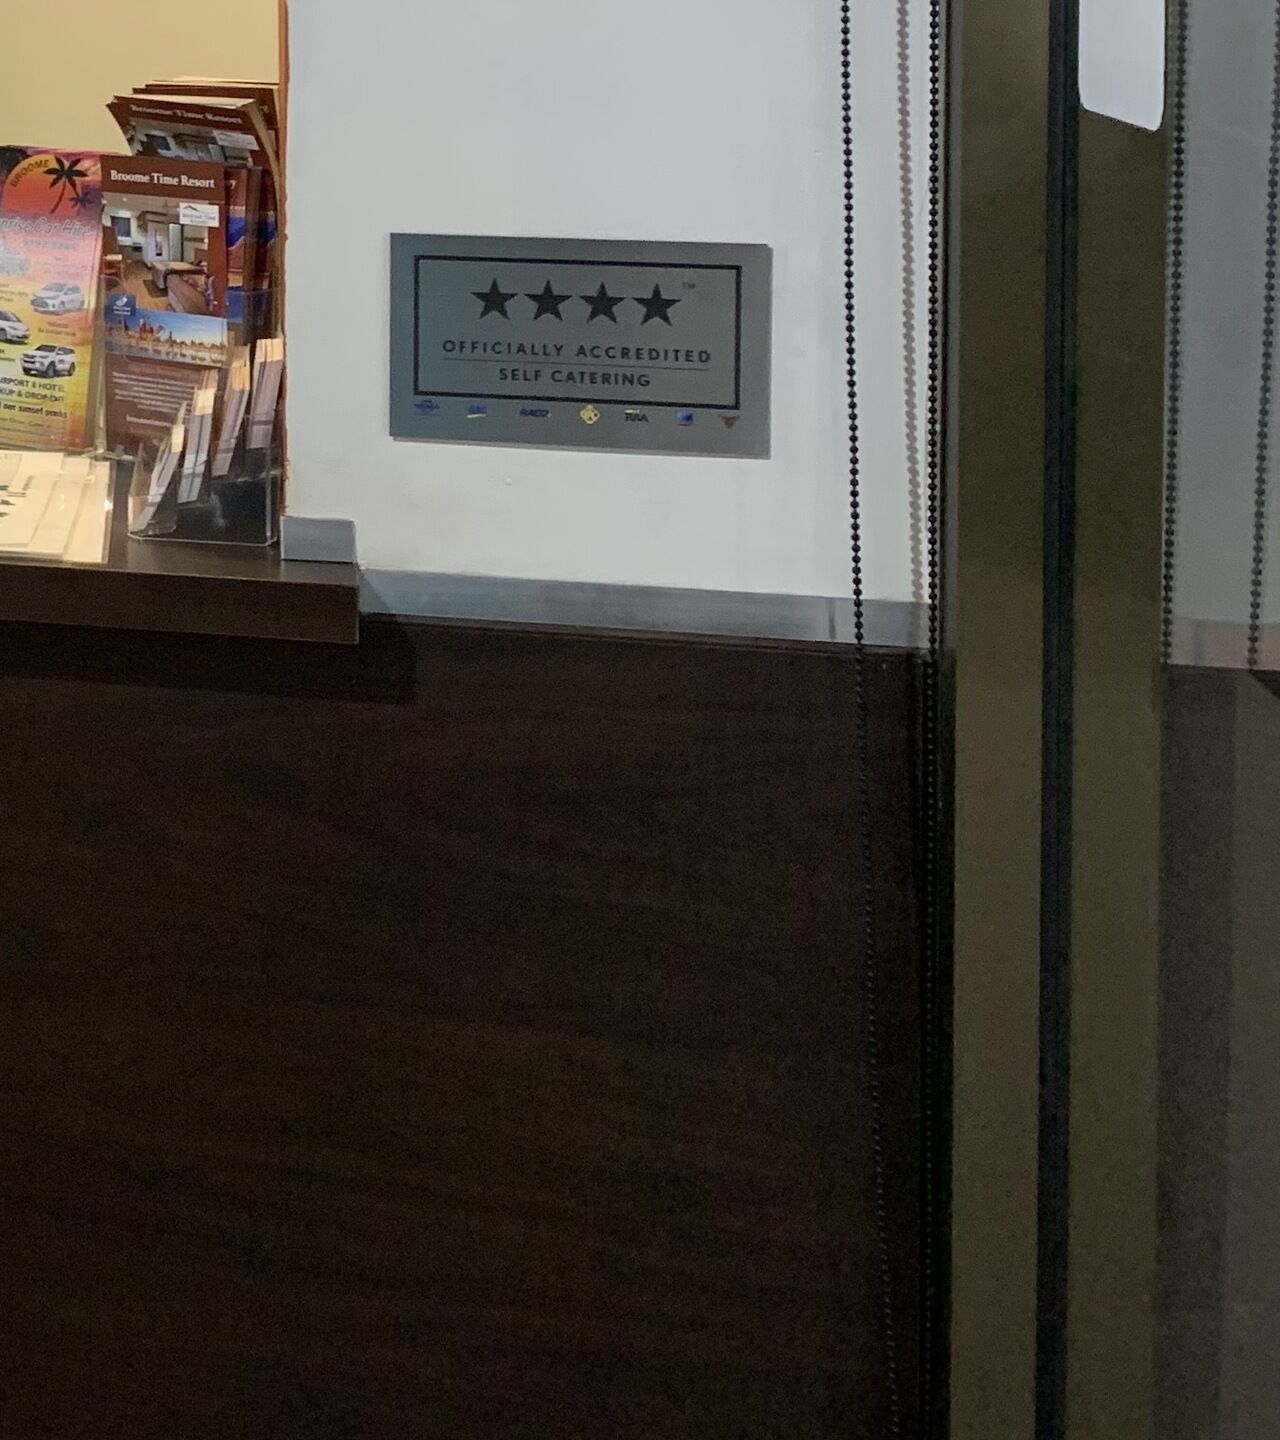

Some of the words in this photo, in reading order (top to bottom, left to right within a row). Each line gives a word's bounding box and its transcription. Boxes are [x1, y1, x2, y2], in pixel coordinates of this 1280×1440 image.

[110, 169, 151, 184] Broome
[151, 172, 180, 185] Time
[181, 175, 216, 189] Resort
[442, 339, 565, 357] OFFICIALLY
[576, 344, 712, 363] ACCREDITED
[499, 367, 542, 381] SELF
[550, 369, 651, 387] CATERING
